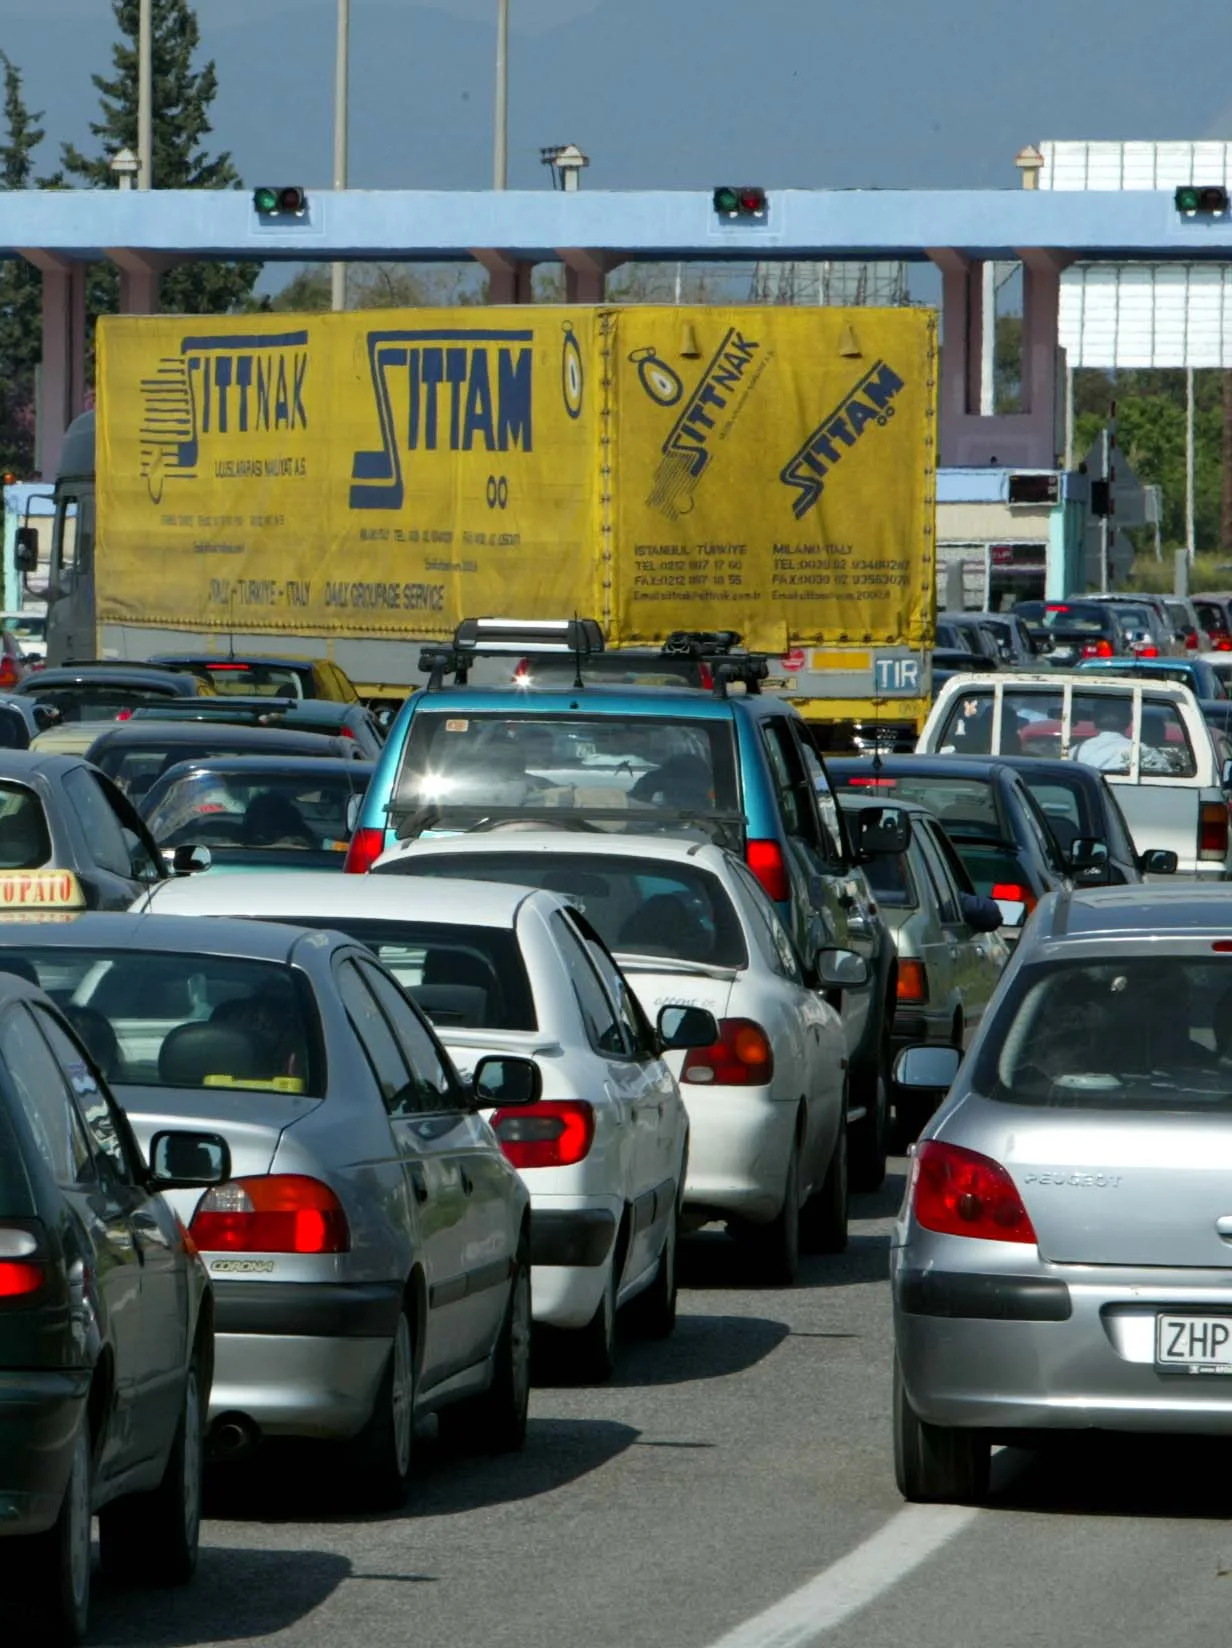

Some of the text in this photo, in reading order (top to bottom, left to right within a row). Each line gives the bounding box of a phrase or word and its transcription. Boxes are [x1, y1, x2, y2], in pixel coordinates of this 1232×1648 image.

[180, 331, 308, 467] SITTNAK
[349, 329, 533, 509] SITTAM
[661, 327, 760, 477] SITTNAK
[780, 360, 905, 520] SITTAM
[876, 659, 918, 688] TIR
[1024, 1172, 1123, 1188] PEUGEOT
